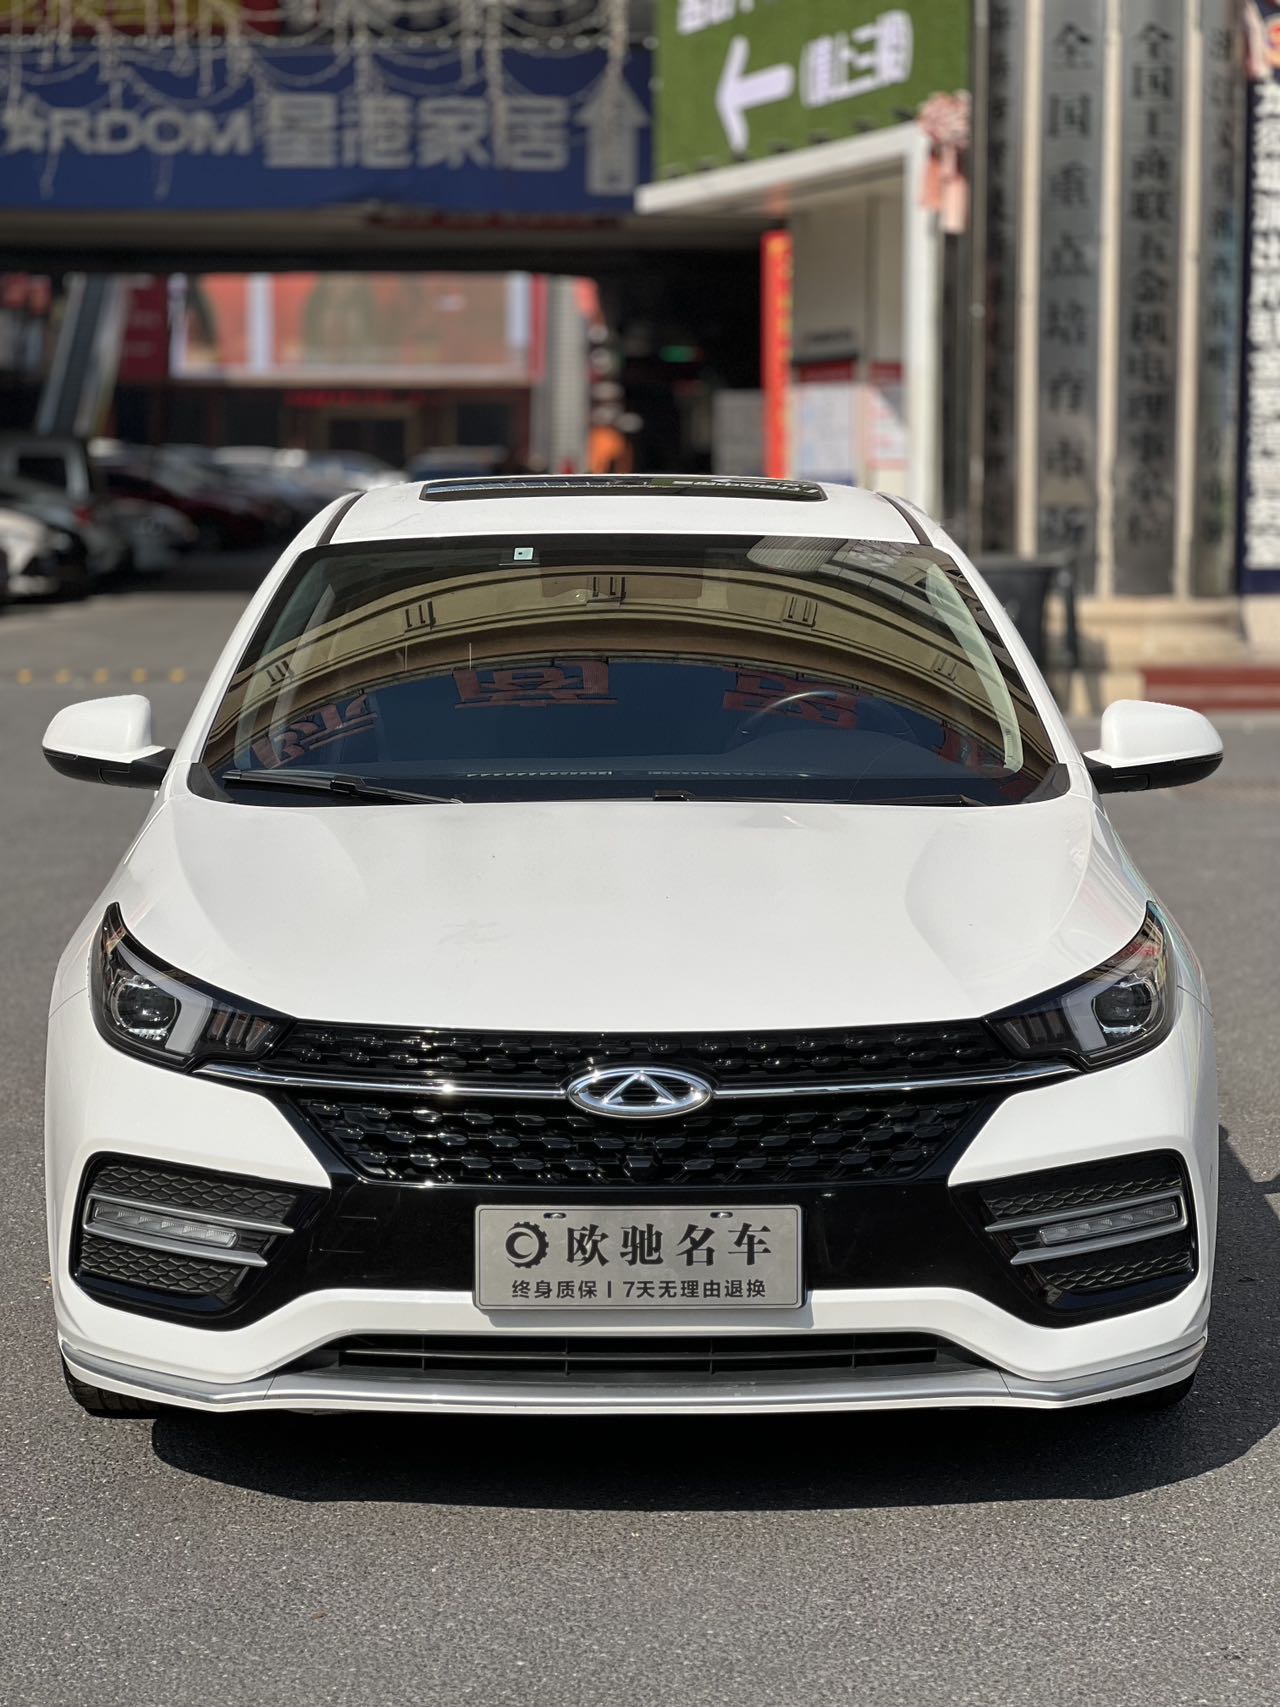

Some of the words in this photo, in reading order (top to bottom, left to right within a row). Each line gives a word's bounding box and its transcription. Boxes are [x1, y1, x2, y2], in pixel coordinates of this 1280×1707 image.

[264, 92, 569, 170] 星港家居
[566, 1222, 772, 1268] 欧驰名车
[511, 1279, 598, 1300] 终身质保
[622, 1279, 766, 1300] 7天无理由退换
